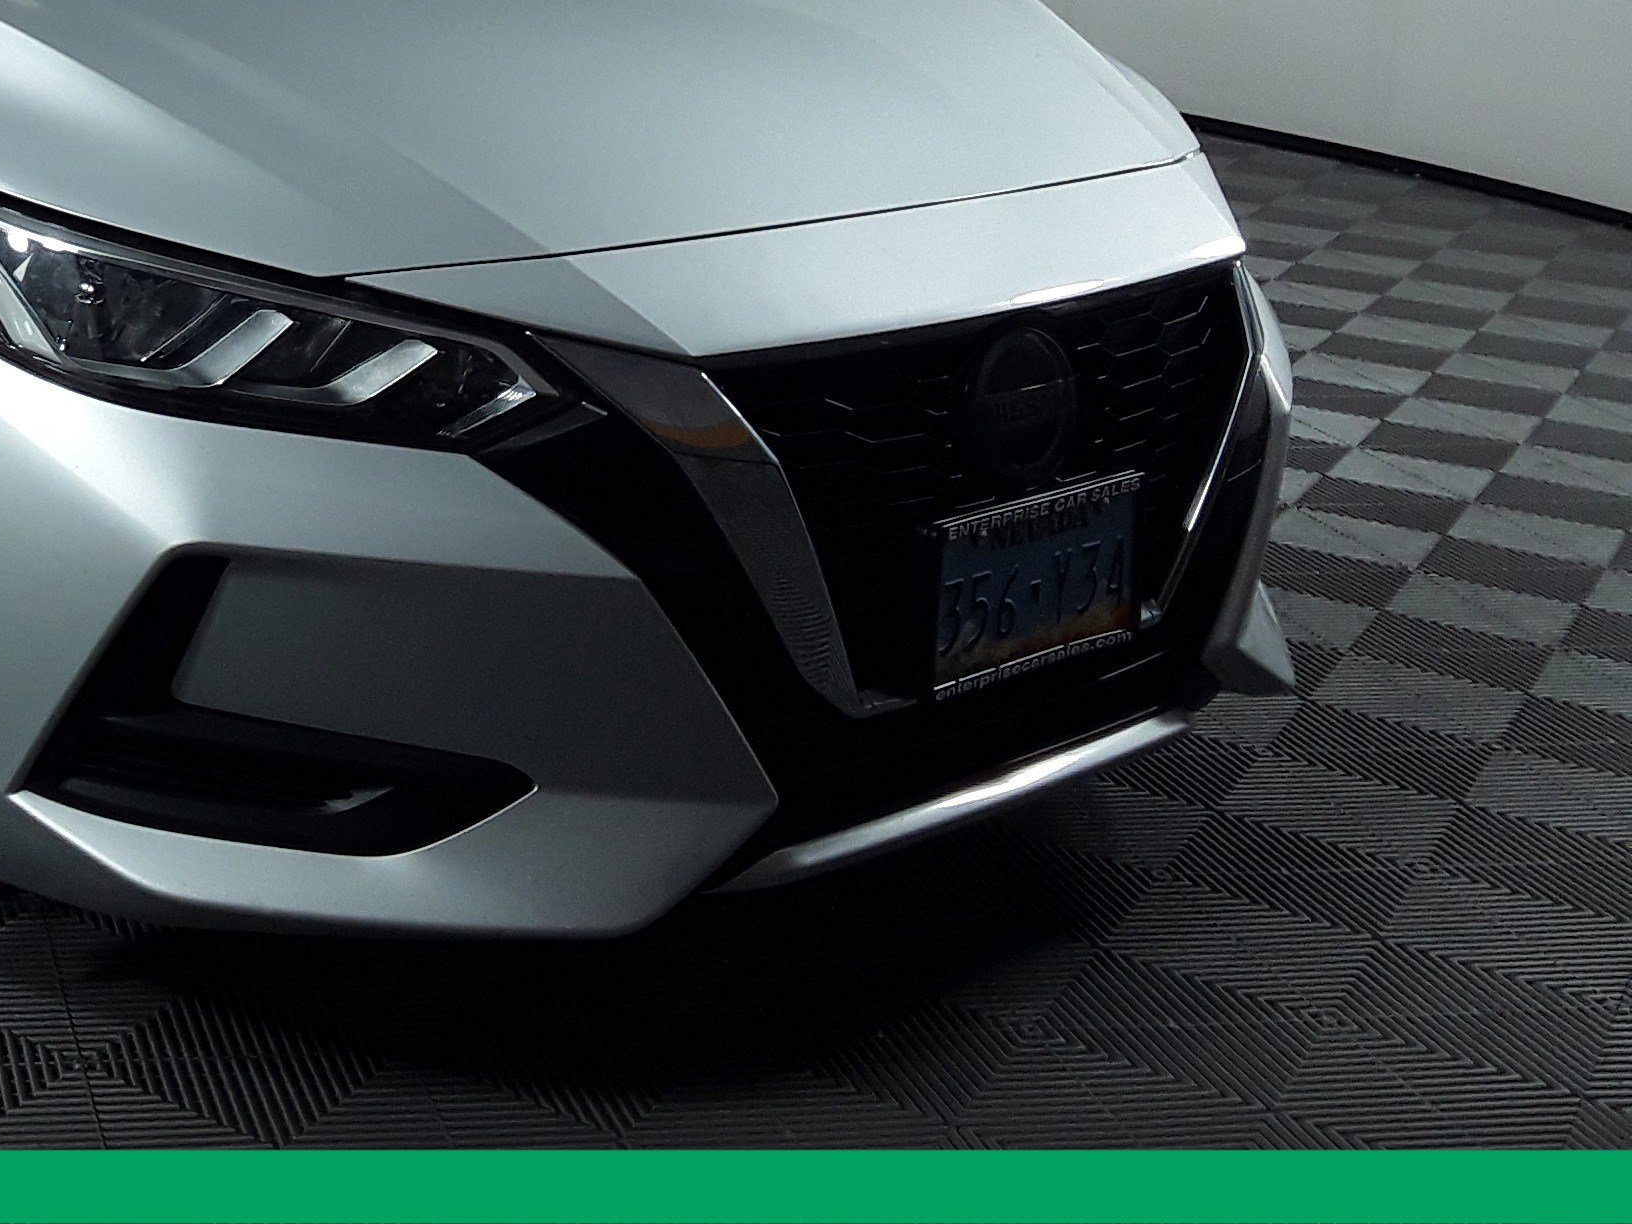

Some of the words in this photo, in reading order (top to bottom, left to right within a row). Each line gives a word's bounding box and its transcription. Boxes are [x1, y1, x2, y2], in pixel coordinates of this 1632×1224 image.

[948, 501, 1051, 541] ENTERPRISE
[1054, 491, 1088, 514] CAR
[1090, 477, 1142, 502] SALES
